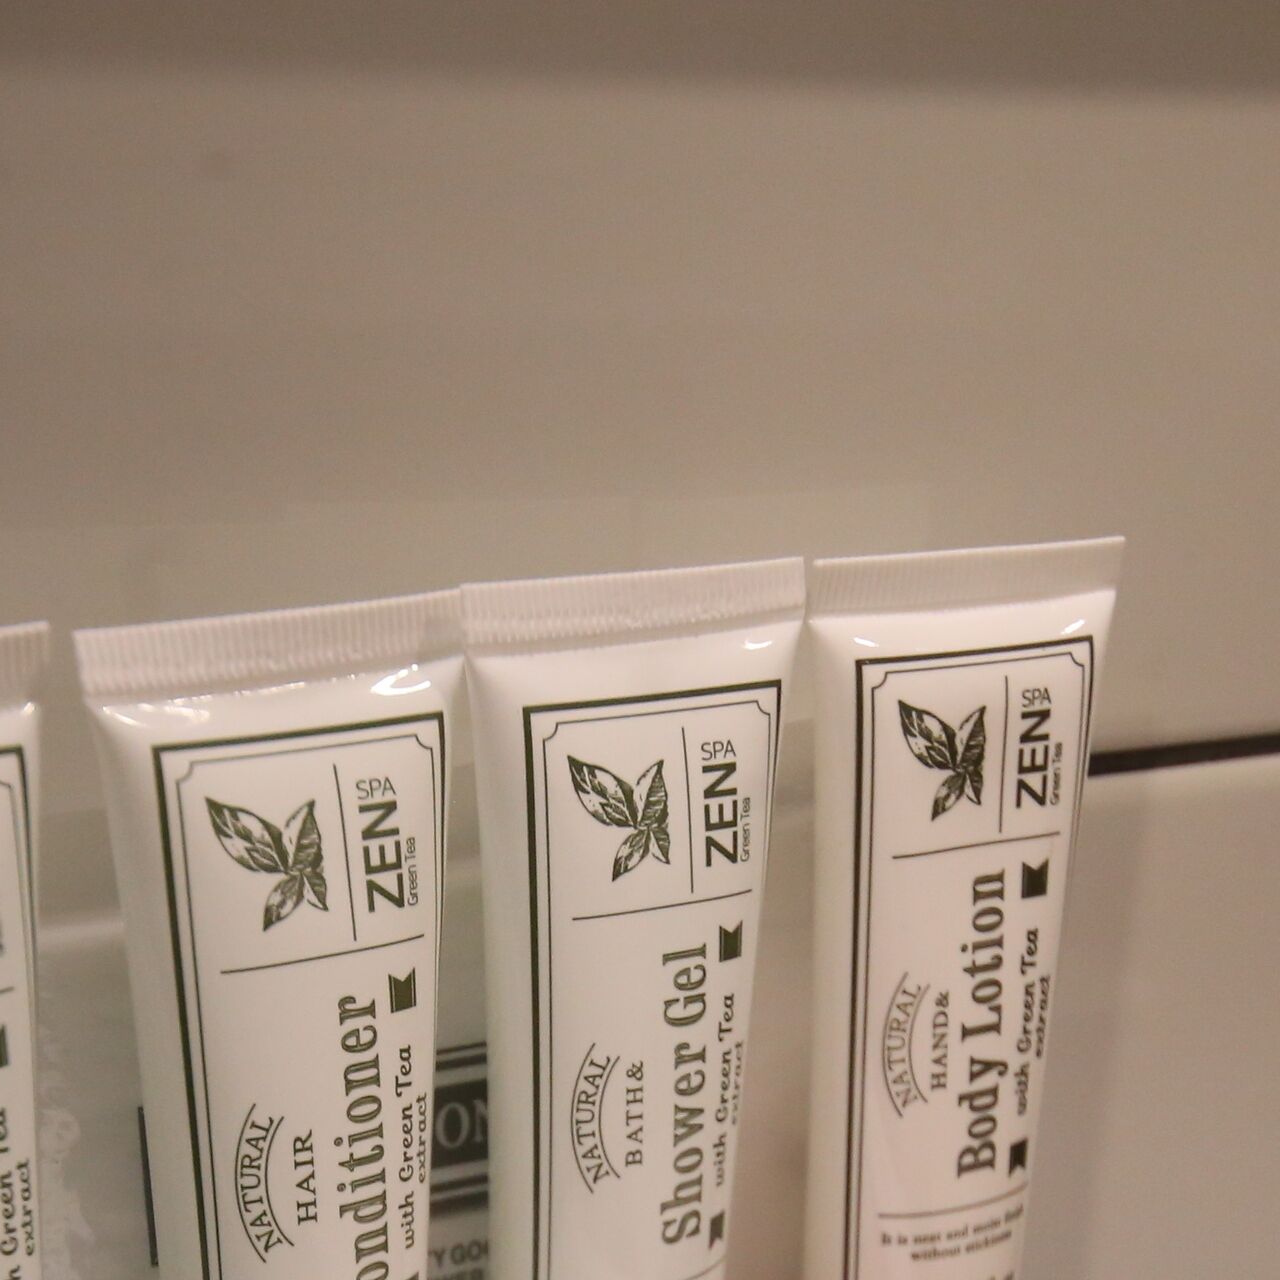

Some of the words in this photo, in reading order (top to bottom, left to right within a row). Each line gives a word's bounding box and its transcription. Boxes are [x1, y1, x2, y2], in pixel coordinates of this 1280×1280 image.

[1022, 687, 1051, 708] SPA
[355, 776, 396, 800] SPA
[701, 740, 736, 761] SPA
[1016, 709, 1051, 809] ZEN
[702, 761, 738, 867] ZEN
[739, 797, 751, 820] Tea
[740, 822, 751, 863] Green
[358, 800, 406, 913] ZEN
[404, 836, 416, 863] Tea
[407, 864, 419, 907] Green
[662, 943, 708, 1028] Gel
[960, 868, 1006, 1043] Lotion
[1021, 927, 1039, 977] Tea
[718, 993, 735, 1043] Tea
[884, 983, 922, 1110] NATURAL
[1017, 983, 1036, 1054] Green
[394, 1043, 412, 1098] Tea
[715, 1048, 732, 1124] Green
[1015, 1063, 1031, 1117] with
[398, 1102, 415, 1183] Green
[417, 1093, 428, 1185] extract
[575, 1056, 611, 1184] NATURAL
[660, 1042, 707, 1246] Shower
[957, 1056, 1009, 1179] Body
[239, 1115, 284, 1253] NATURAL
[293, 1128, 318, 1226] HAIR
[712, 1132, 727, 1187] with
[0, 1170, 19, 1256] Green
[16, 1157, 35, 1257] extract
[397, 1190, 415, 1250] with
